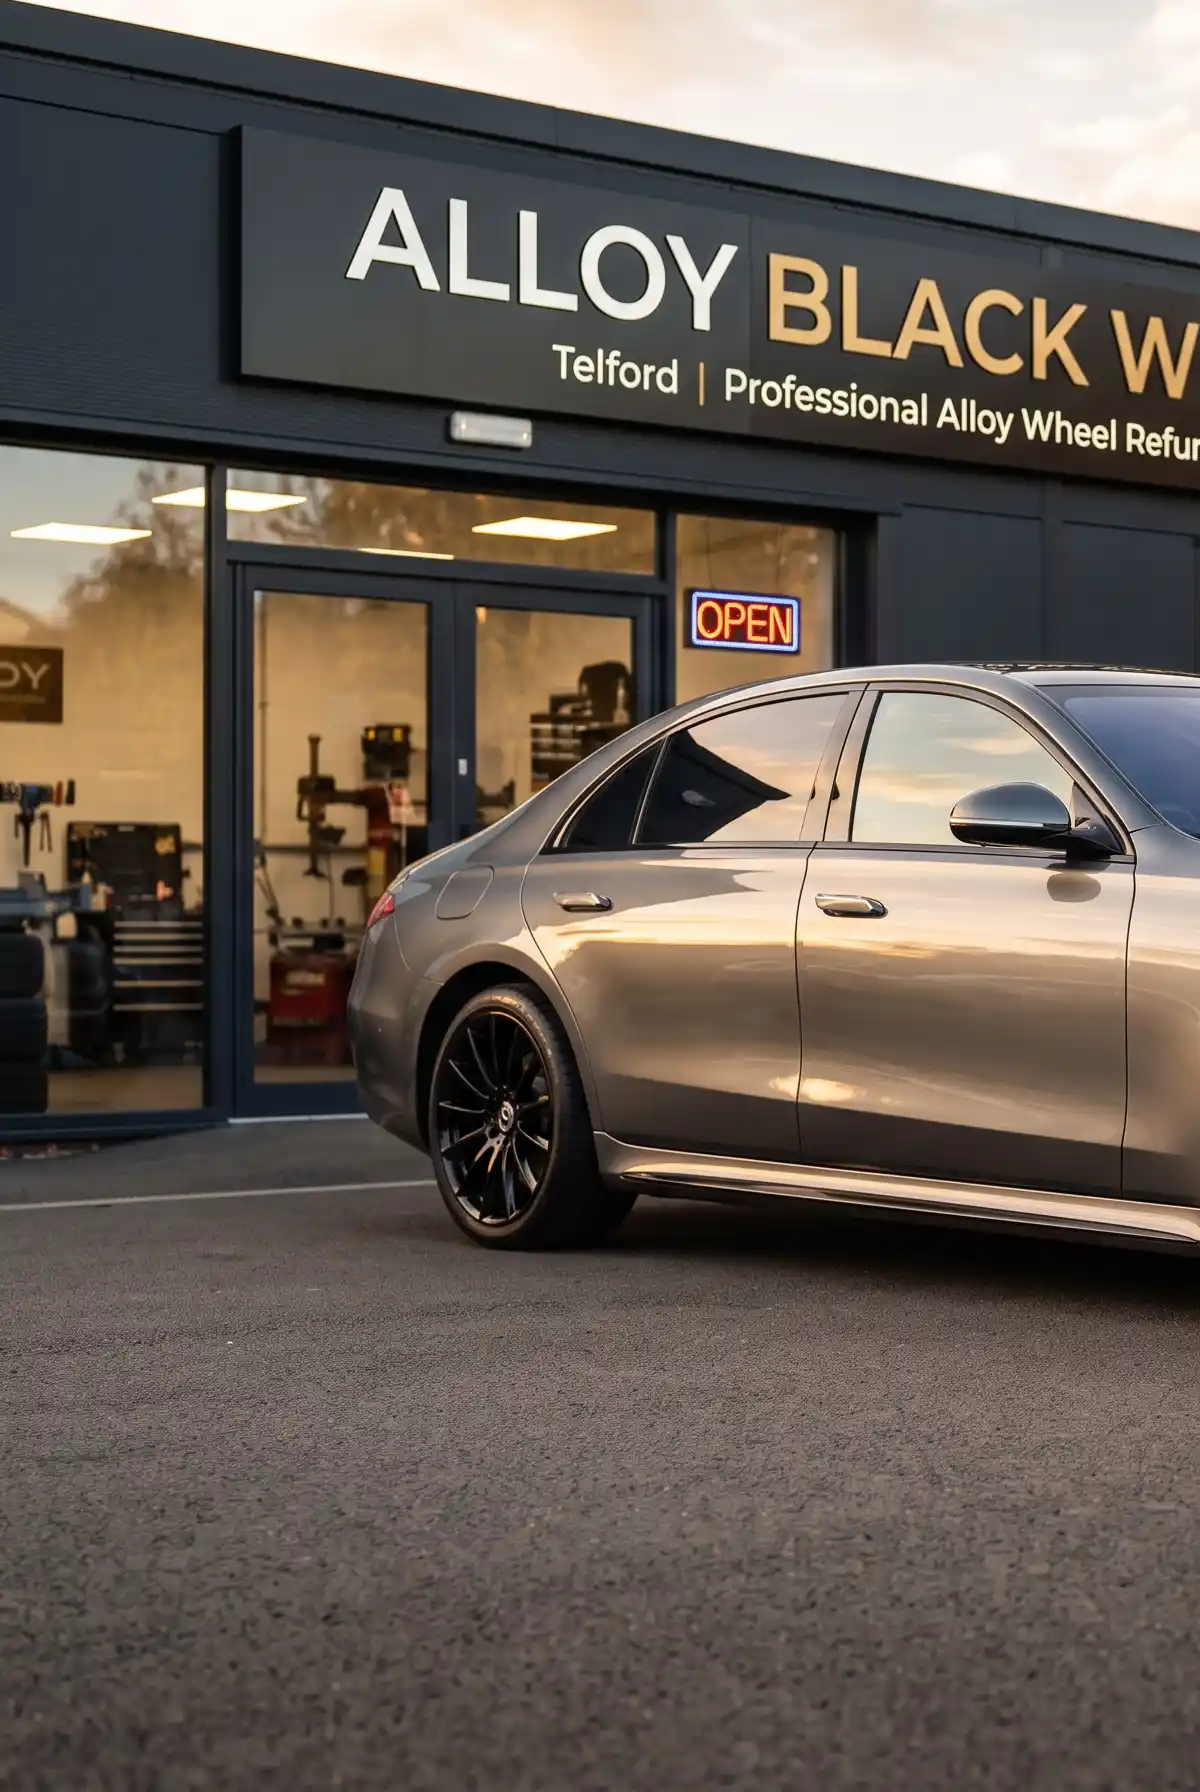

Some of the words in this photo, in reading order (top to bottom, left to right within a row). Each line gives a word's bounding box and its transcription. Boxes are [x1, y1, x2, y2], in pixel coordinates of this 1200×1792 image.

[346, 187, 738, 331] ALLOY
[768, 253, 1089, 386] BLACK
[552, 344, 679, 395] Telford
[724, 367, 928, 428] Professional
[937, 397, 1015, 445] Alloy
[1020, 407, 1117, 451] Wheel
[697, 600, 792, 643] OPEN
